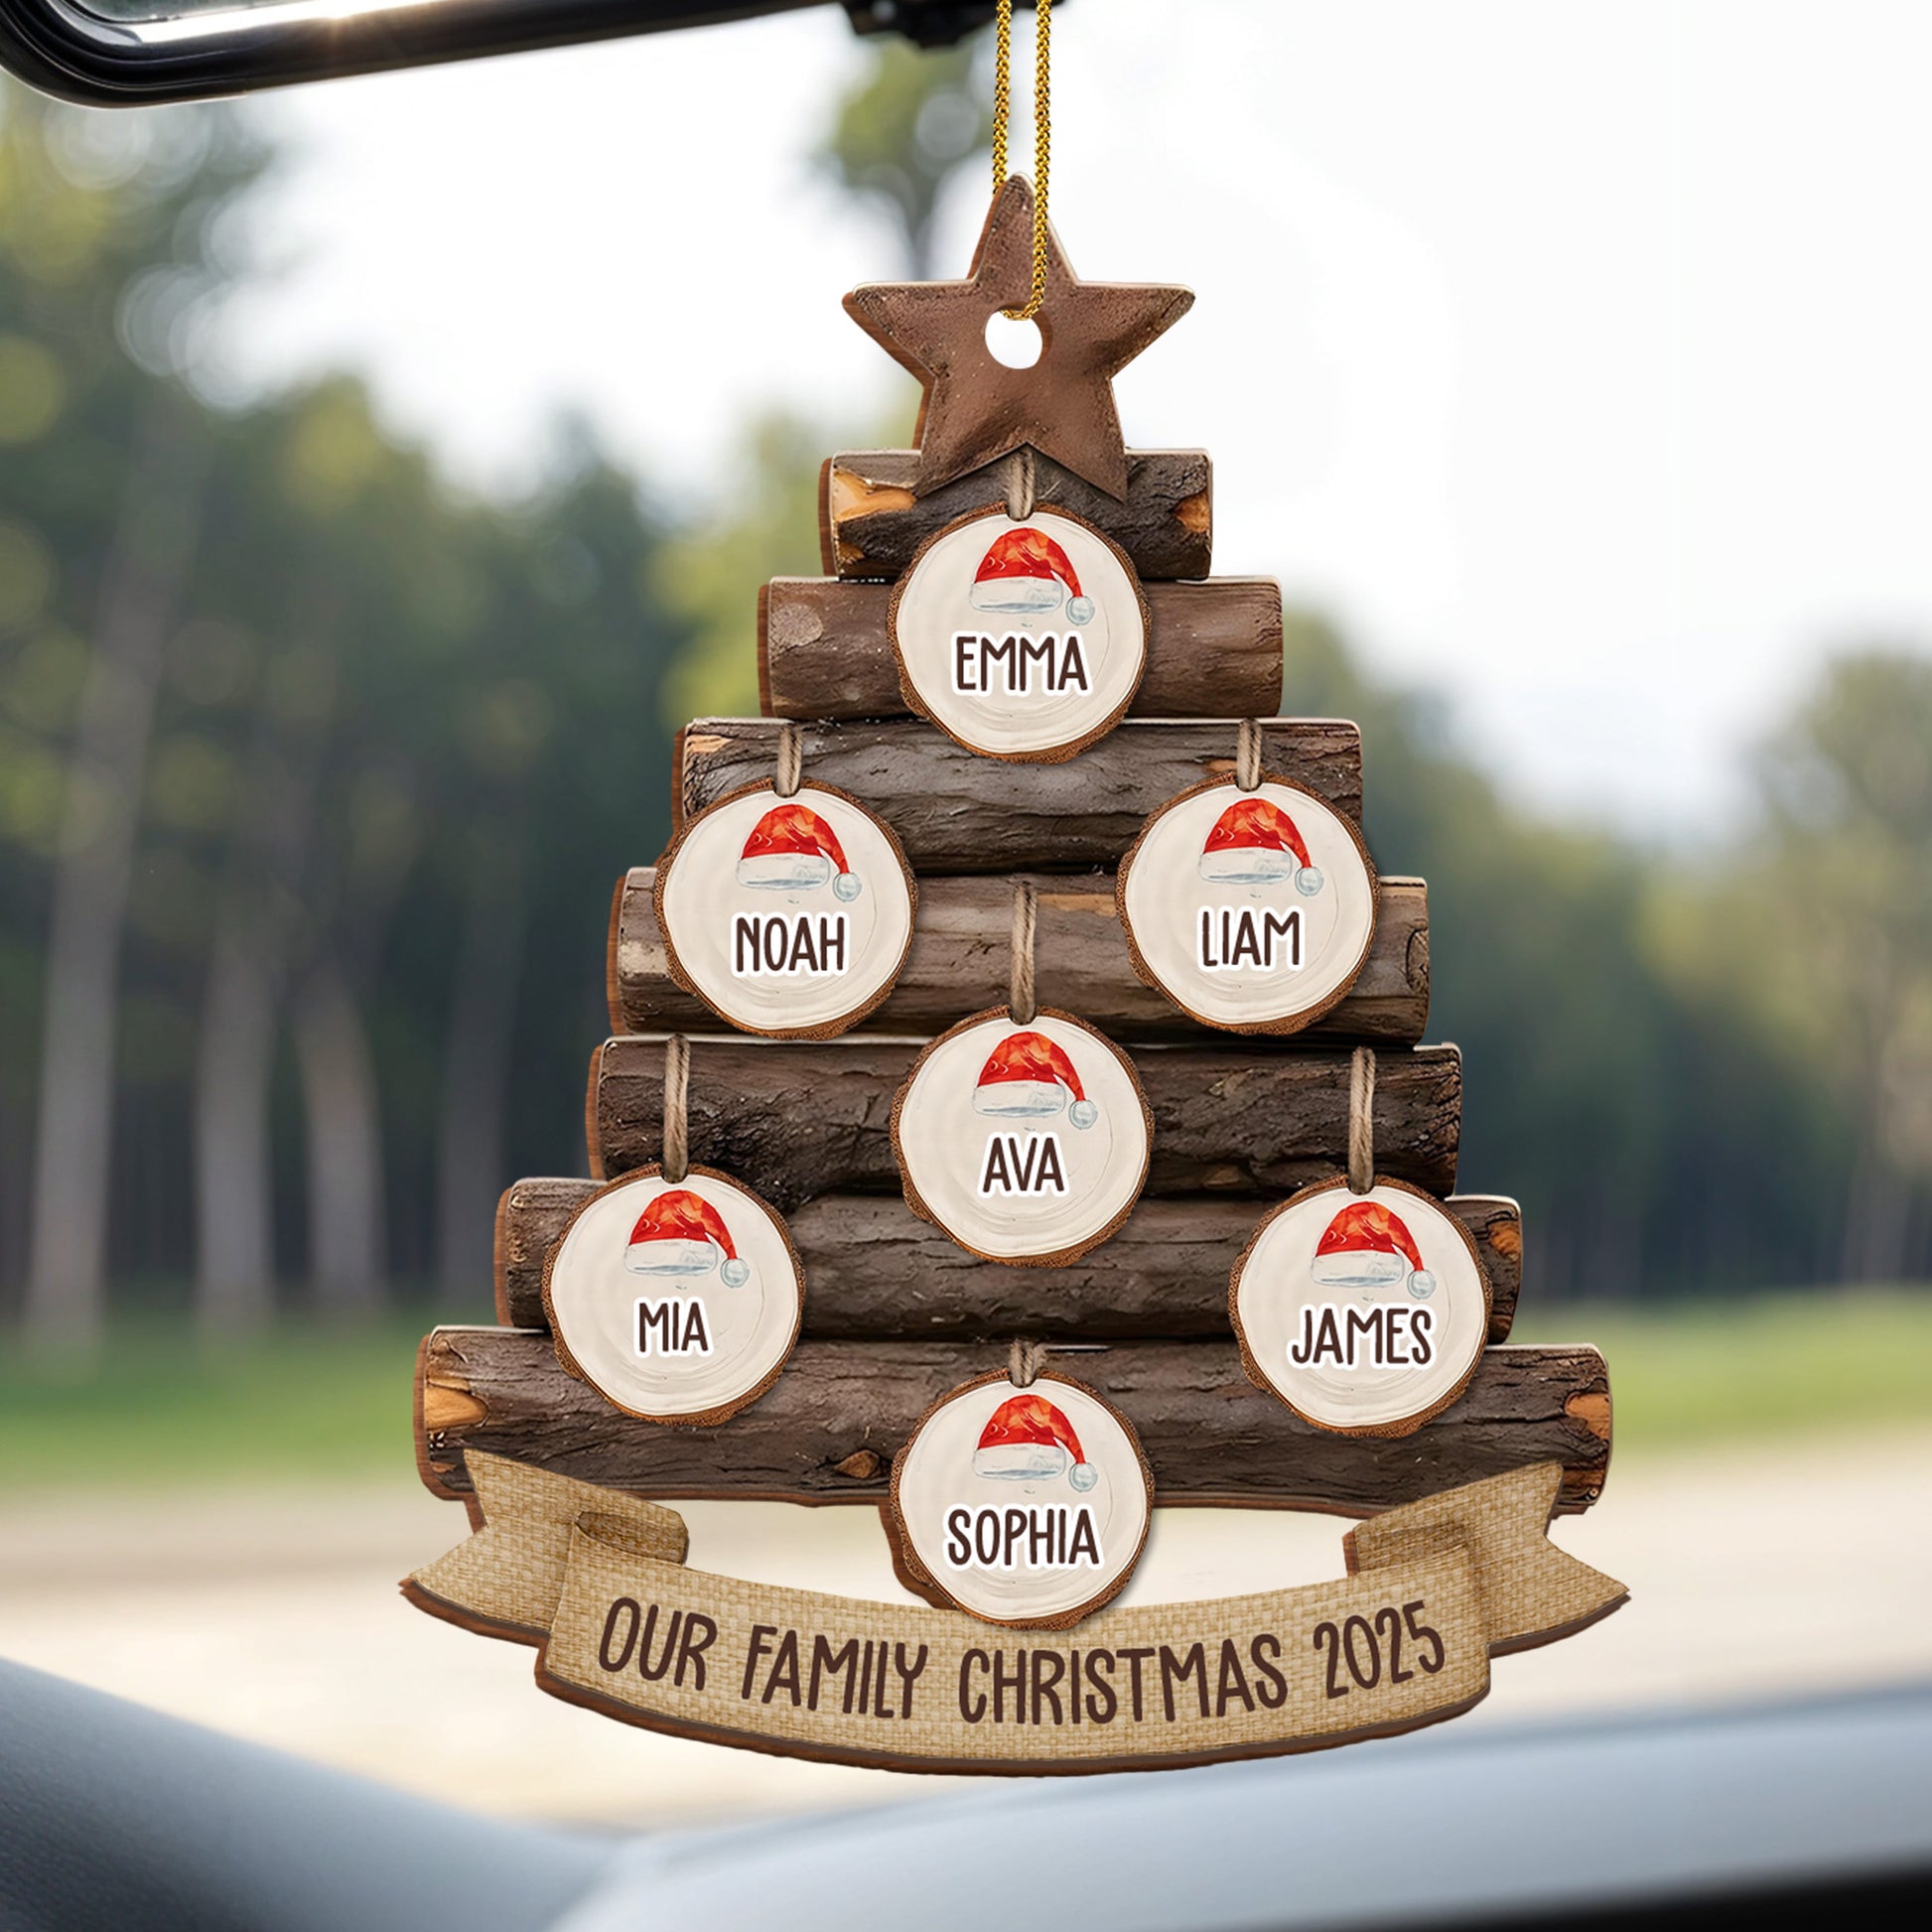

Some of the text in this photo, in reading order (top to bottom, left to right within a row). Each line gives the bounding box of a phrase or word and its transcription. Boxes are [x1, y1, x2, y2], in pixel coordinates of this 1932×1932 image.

[956, 635, 1088, 692] EMMA
[737, 916, 845, 972] NOAH
[1202, 910, 1300, 967] LIAM
[983, 1137, 1064, 1193] AVA
[639, 1302, 709, 1353] MIA
[1292, 1308, 1432, 1365] JAMES
[948, 1508, 1100, 1566] SOPHIA
[598, 1596, 1446, 1725] OUR FAMILY CHRISTMAS 2025
